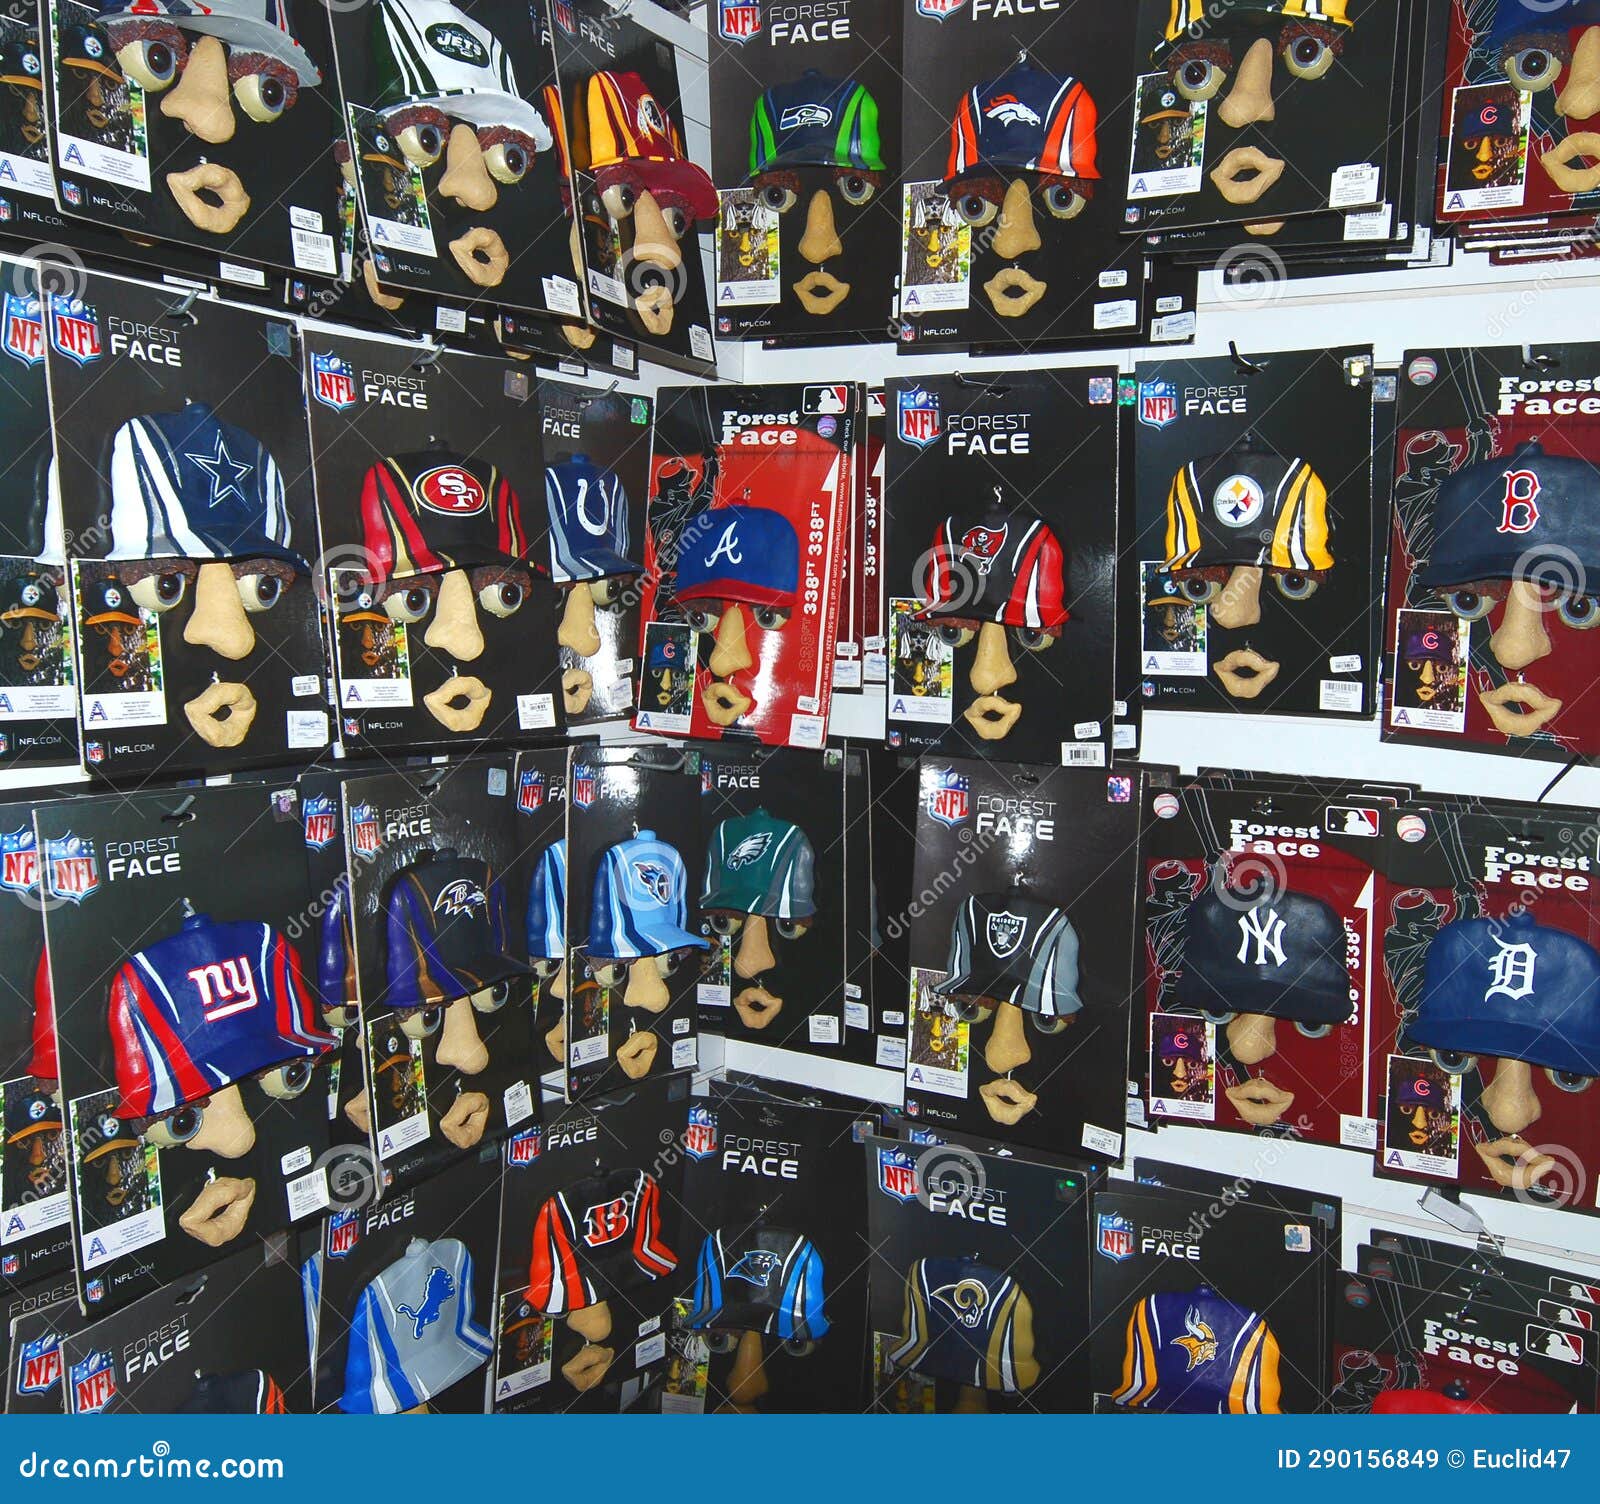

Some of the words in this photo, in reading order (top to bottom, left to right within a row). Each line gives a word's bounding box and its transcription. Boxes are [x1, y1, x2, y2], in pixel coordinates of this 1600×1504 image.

[725, 7, 761, 35] NFL
[770, 2, 850, 23] FOREST
[580, 22, 616, 58] FACE
[771, 18, 850, 45] FACE
[437, 32, 482, 57] JETS
[58, 316, 101, 355] NFL
[108, 317, 180, 344] FOREST
[111, 335, 182, 367] FACE
[319, 373, 356, 404] NFL
[362, 370, 427, 391] FOREST
[1184, 385, 1247, 399] FOREST
[364, 385, 428, 410] FACE
[1144, 397, 1177, 420] NFL
[1185, 398, 1247, 416] FACE
[1498, 394, 1600, 416] Face
[543, 405, 581, 422] FOREST
[722, 411, 799, 425] Forest
[904, 410, 940, 439] NFL
[947, 414, 1030, 431] FOREST
[543, 418, 580, 438] FACE
[721, 426, 798, 445] Face
[948, 433, 1029, 455] FACE
[1497, 470, 1542, 534] B
[809, 502, 825, 555] 338FT
[704, 521, 742, 567] A
[803, 561, 820, 615] 338FT
[368, 722, 403, 730] NFL.COM
[19, 736, 61, 745] NFL.COM
[114, 744, 155, 754] NFL.COM
[909, 736, 941, 745] NFL.COM
[717, 764, 760, 775] FOREST
[549, 787, 567, 802] FA
[576, 779, 595, 804] NFL
[718, 776, 760, 789] FACE
[522, 785, 543, 807] NFL
[935, 790, 969, 818] NFL
[976, 796, 1057, 816] FOREST
[385, 804, 430, 823] FOREST
[306, 815, 336, 841] NFL
[356, 821, 381, 849] NFL
[387, 818, 432, 841] FACE
[1230, 820, 1320, 839] Forest
[105, 836, 179, 858] FOREST
[1230, 835, 1320, 858] Face
[1484, 846, 1590, 871] Forest
[55, 859, 98, 891] NFL
[108, 853, 181, 881] FACE
[1484, 861, 1589, 891] Face
[549, 1115, 600, 1135] FOREST
[927, 1108, 957, 1120] NFL.COM
[513, 1138, 541, 1162] NFL
[548, 1127, 598, 1151] FACE
[687, 1125, 717, 1153] NFL
[723, 1135, 801, 1156] FOREST
[722, 1152, 798, 1179] FACE
[885, 1170, 920, 1195] NFL
[928, 1177, 1007, 1203] FOREST
[367, 1201, 415, 1235] FACE
[929, 1193, 1007, 1226] FACE
[333, 1221, 358, 1252] NFL
[1103, 1230, 1134, 1254] NFL
[1141, 1226, 1199, 1244] FOREST
[1141, 1238, 1200, 1260] FACE
[8, 1283, 76, 1316] FORES
[123, 1312, 188, 1358] FOREST
[1424, 1320, 1520, 1357] Forest
[126, 1330, 190, 1382] FACE
[1424, 1335, 1519, 1376] Face
[77, 1373, 117, 1414] NFL
